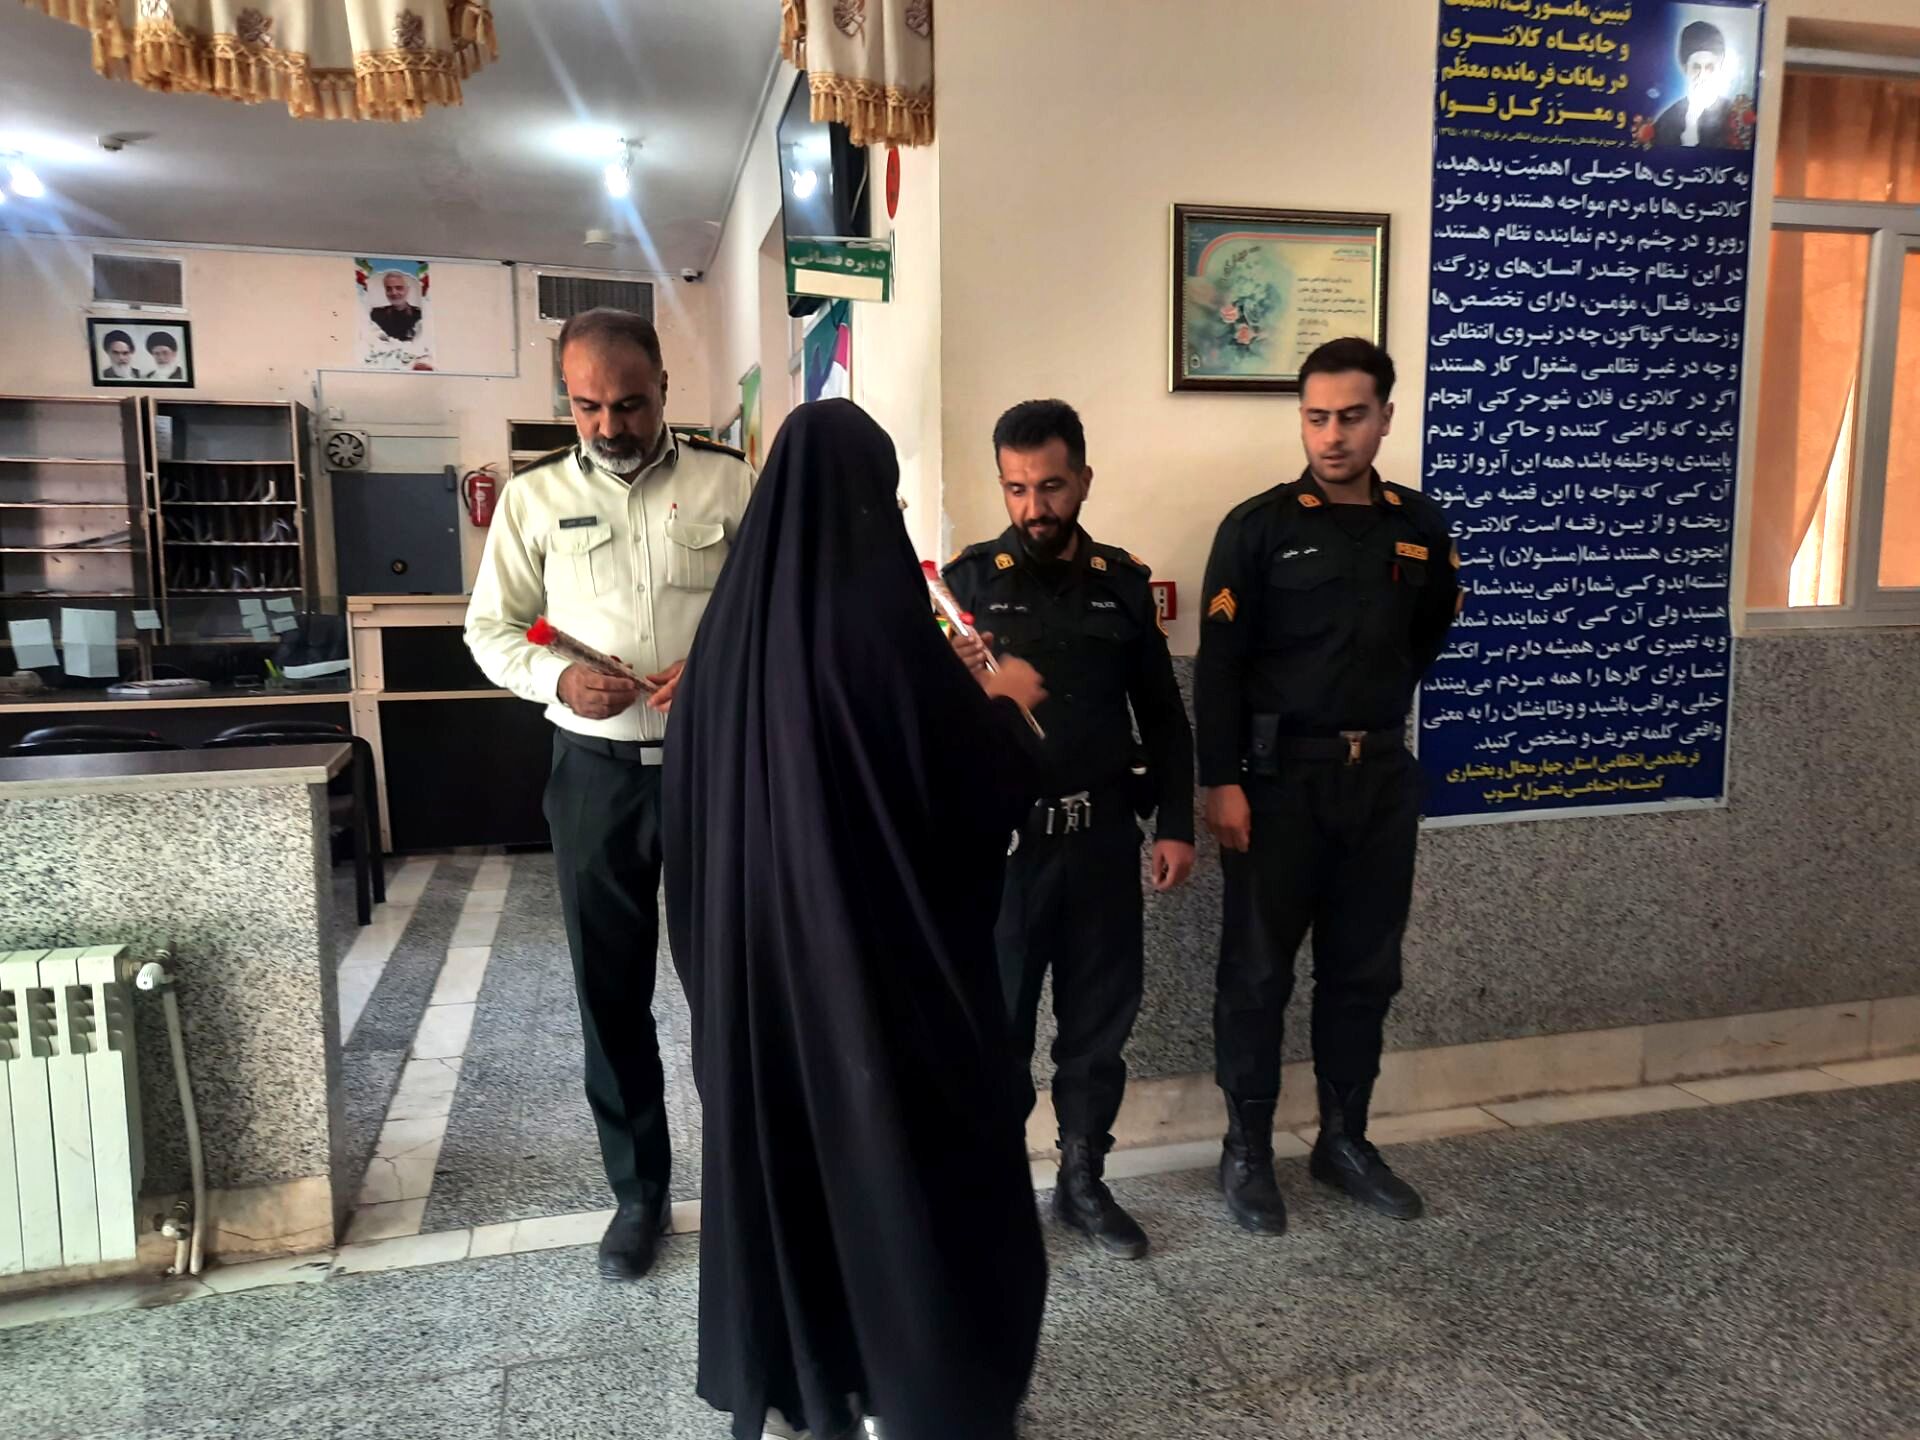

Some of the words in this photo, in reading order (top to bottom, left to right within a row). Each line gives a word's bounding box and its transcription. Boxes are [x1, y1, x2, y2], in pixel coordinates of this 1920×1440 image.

[1442, 25, 1542, 55] کلانتری
[1546, 30, 1617, 59] جایگاه
[1618, 44, 1630, 62] و
[1555, 66, 1605, 88] بیانات
[1607, 74, 1628, 94] در
[1440, 90, 1497, 118] قوا
[1498, 95, 1542, 121] کل
[1615, 111, 1626, 129] و
[1572, 159, 1632, 185] خیلی
[1733, 172, 1748, 191] به
[1435, 187, 1471, 212] طور
[1473, 192, 1489, 211] به
[1491, 194, 1502, 212] و
[1504, 194, 1554, 208] هستند
[1557, 194, 1606, 218] مواجه
[1608, 199, 1647, 220] مردم
[1649, 197, 1659, 219] با
[1494, 223, 1531, 247] نظام
[1595, 231, 1635, 252] مردم
[1638, 229, 1676, 252] چشم
[1680, 234, 1699, 251] در
[1586, 261, 1640, 283] چقدر
[1645, 262, 1688, 285] نظام
[1692, 264, 1721, 287] این
[1724, 268, 1742, 285] در
[1528, 291, 1576, 312] دارای
[1431, 322, 1494, 346] انتظامی
[1495, 324, 1553, 347] نیروی
[1557, 327, 1575, 345] در
[1577, 328, 1601, 347] چه
[1491, 355, 1519, 376] کار
[1522, 356, 1577, 380] مشغول
[1581, 357, 1639, 380] نظامی
[1642, 358, 1676, 381] غیر
[1680, 361, 1699, 378] در
[1702, 362, 1725, 380] چه
[1428, 388, 1472, 411] انجام
[1577, 388, 1613, 409] فلان
[1619, 388, 1682, 412] کلانتری
[1686, 393, 1706, 409] در
[1711, 389, 1735, 413] اگر
[1427, 424, 1464, 444] عدم
[1469, 421, 1485, 441] از
[1489, 420, 1540, 444] حاکی
[1545, 425, 1555, 442] و
[1560, 420, 1608, 437] کننده
[1612, 420, 1666, 444] ناراضی
[1671, 420, 1693, 436] که
[1696, 420, 1733, 443] بگیرد
[1426, 453, 1457, 477] نظر
[1511, 453, 1540, 476] این
[1542, 456, 1575, 468] همه
[1577, 452, 1612, 473] باشد
[1614, 452, 1659, 473] وظیفه
[1661, 455, 1675, 472] به
[1497, 483, 1537, 505] قضیه
[1541, 484, 1570, 507] این
[1574, 483, 1585, 504] با
[1589, 483, 1636, 506] مواجه
[1641, 482, 1663, 498] که
[1666, 481, 1707, 505] کسی
[1710, 479, 1731, 501] آن
[1448, 515, 1519, 540] کلانتری
[1565, 514, 1605, 534] رفته
[1609, 520, 1645, 537] بین
[1648, 513, 1663, 533] از
[1666, 517, 1676, 534] و
[1614, 547, 1660, 560] هستند
[1473, 578, 1502, 595] شما
[1572, 577, 1586, 596] را
[1587, 575, 1614, 592] شما
[1616, 574, 1656, 598] کسی
[1492, 609, 1548, 630] نماینده
[1552, 607, 1575, 624] که
[1578, 605, 1618, 630] کسی
[1621, 602, 1645, 625] آن
[1648, 604, 1678, 627] ولی
[1682, 606, 1725, 623] هستید
[1506, 640, 1542, 662] دارم
[1545, 638, 1593, 659] همیشه
[1596, 642, 1621, 659] من
[1624, 634, 1646, 651] که
[1701, 636, 1715, 652] به
[1550, 672, 1581, 685] همه
[1587, 668, 1600, 687] را
[1605, 664, 1647, 686] کارها
[1691, 662, 1725, 678] شما
[1497, 674, 1544, 694] مردم
[1485, 703, 1499, 723] را
[1589, 696, 1628, 717] باشید
[1631, 693, 1679, 716] مراقب
[1681, 692, 1723, 715] خیلی
[1423, 708, 1463, 729] معنی
[1467, 707, 1482, 724] به
[1518, 729, 1577, 754] مشخص
[1580, 732, 1590, 749] و
[1641, 722, 1679, 740] کلمه
[1679, 720, 1722, 744] واقعی
